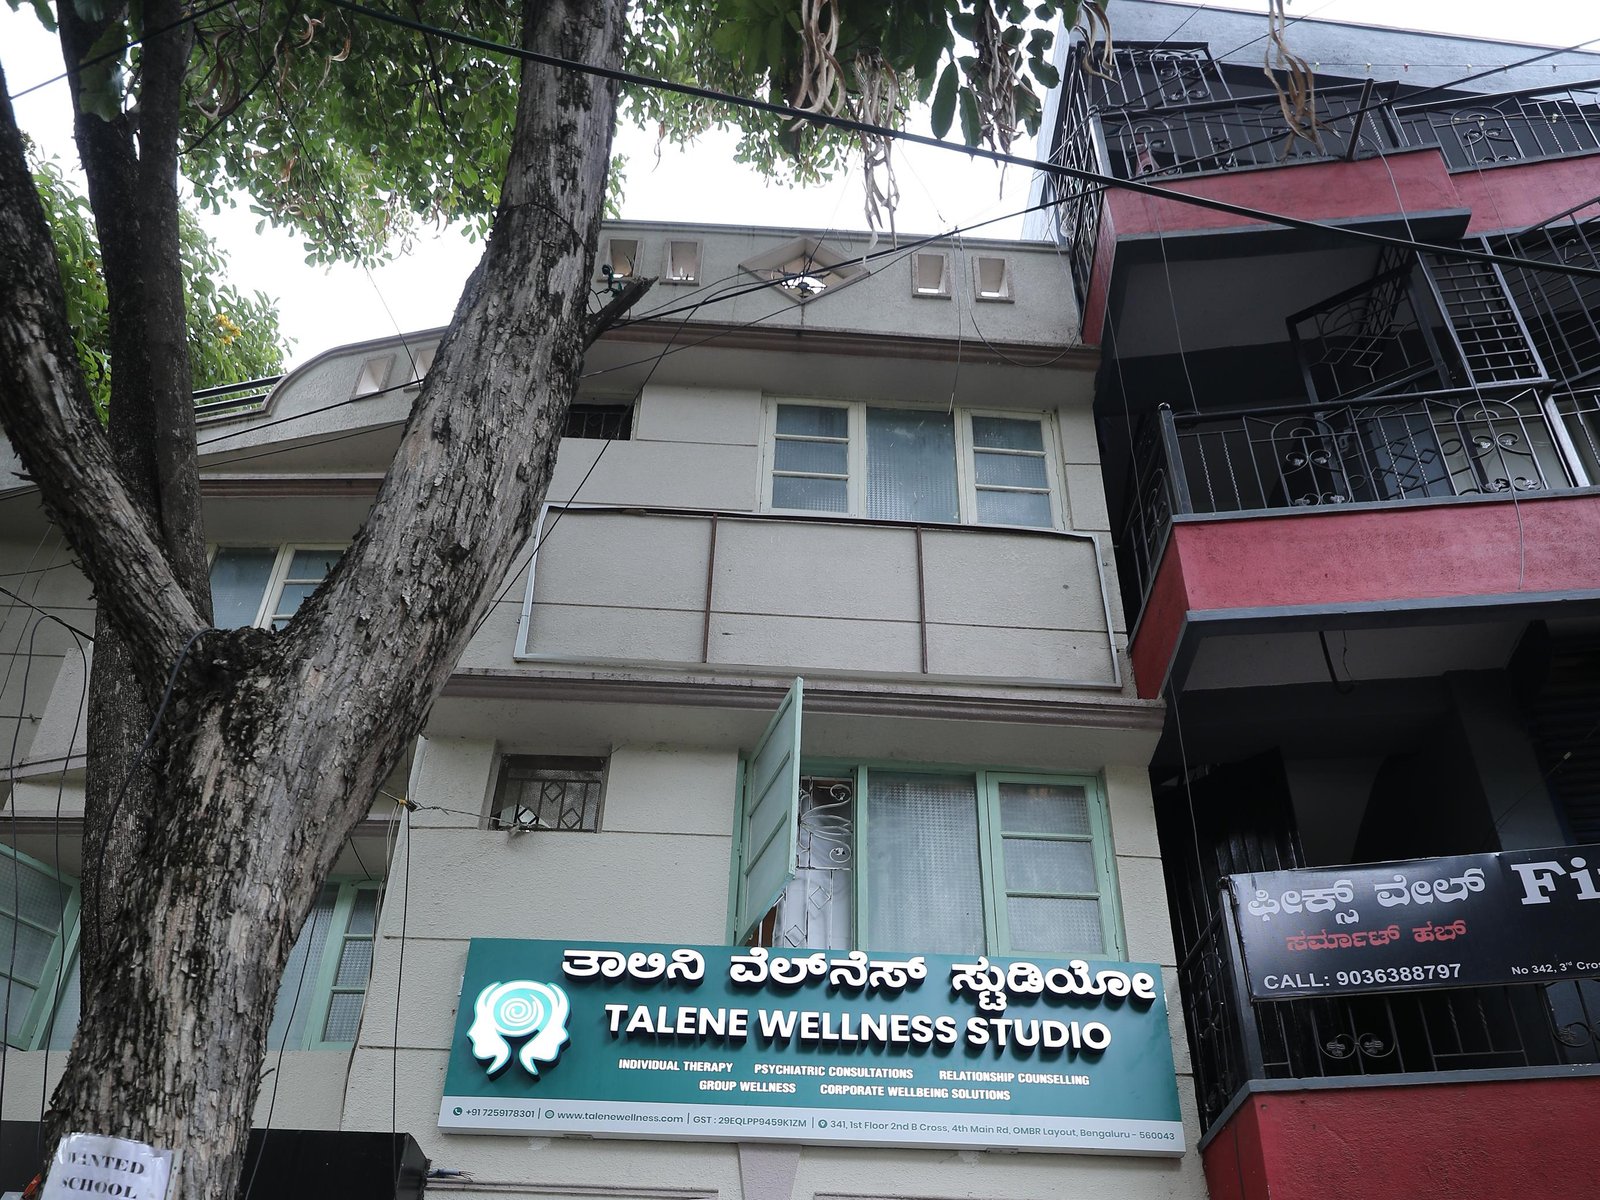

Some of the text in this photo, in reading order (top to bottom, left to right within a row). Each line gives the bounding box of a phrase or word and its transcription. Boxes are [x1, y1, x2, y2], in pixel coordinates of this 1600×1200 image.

[1510, 857, 1600, 905] Fi
[562, 948, 705, 981] ತಾಲಿನಿ
[1511, 965, 1529, 975] No
[1531, 964, 1557, 974] 342,
[1263, 963, 1462, 990] CALL: 9036388797
[604, 1003, 1112, 1050] TALENE WELLNESS STUDIO
[618, 1059, 733, 1073] INDIVIDUAL THERAPY
[754, 1064, 914, 1079] PSYCHIATRIC CONSULTATIONS
[939, 1070, 1090, 1086] RELATIONSHIP COUNSELLING
[699, 1080, 796, 1093] GROUP WELLNESS
[820, 1084, 1011, 1101] CORPORATE WELLBEING SOLUTIONS
[466, 1108, 535, 1118] +91 7259178301
[557, 1110, 683, 1124] www.talenewellness.com
[693, 1115, 712, 1125] GST
[830, 1120, 848, 1130] 341,
[850, 1121, 863, 1129] 1st
[864, 1122, 889, 1131] Floor
[890, 1122, 909, 1131] 2nd
[911, 1123, 918, 1131] B
[919, 1123, 950, 1133] Cross,
[951, 1124, 968, 1133] 4th
[970, 1125, 994, 1134] Main
[996, 1126, 1011, 1135] Rd,
[1012, 1126, 1041, 1136] OMBR
[1043, 1127, 1078, 1138] Layout,
[1080, 1129, 1130, 1140] Bengaluru
[1139, 1131, 1175, 1140] 560043
